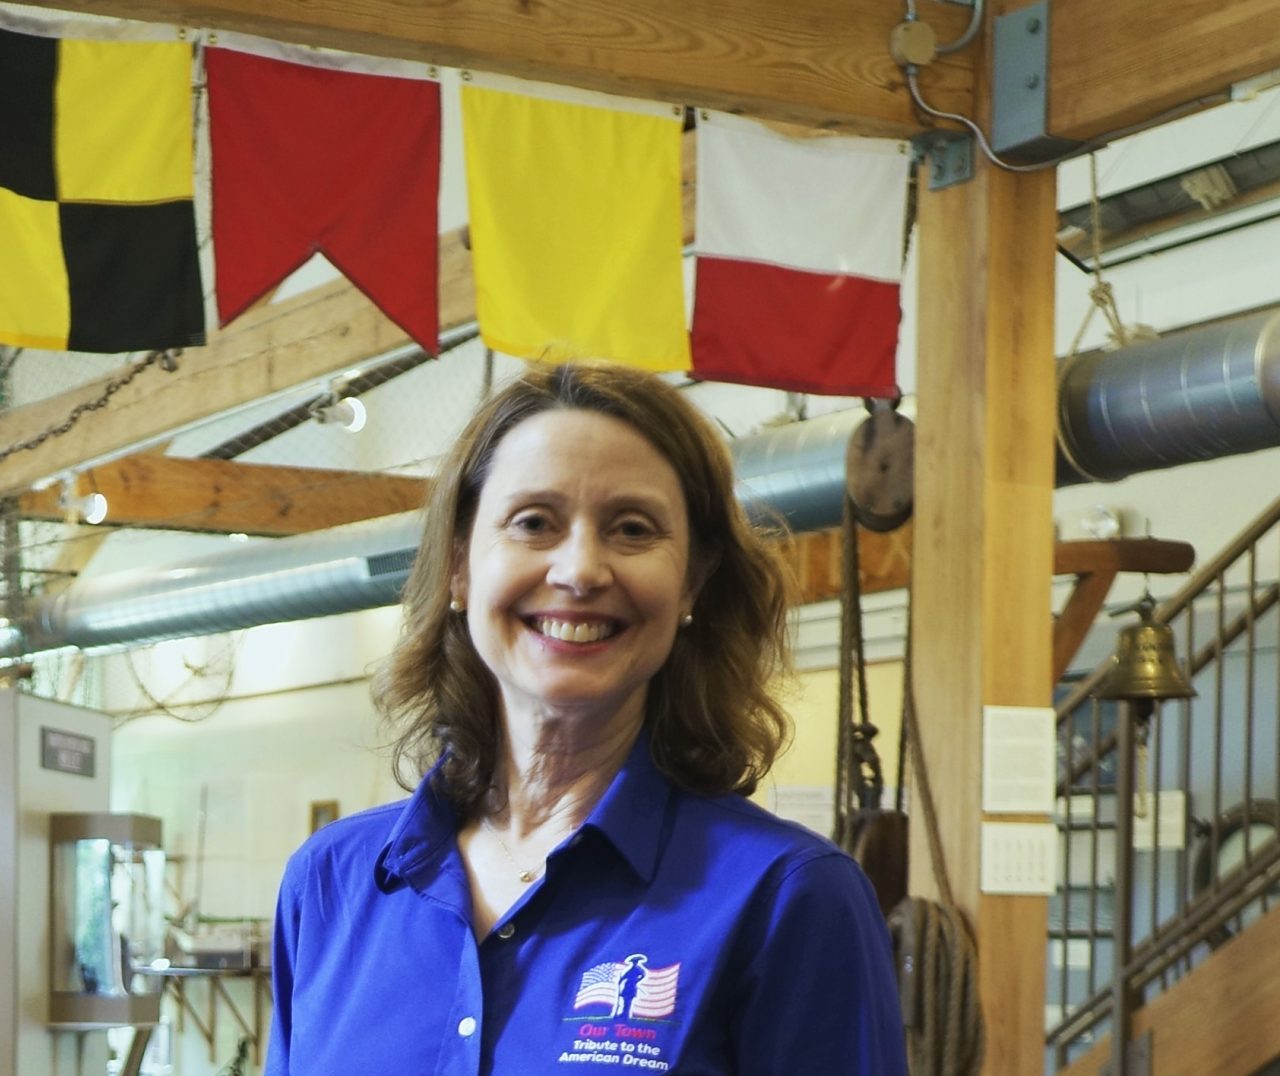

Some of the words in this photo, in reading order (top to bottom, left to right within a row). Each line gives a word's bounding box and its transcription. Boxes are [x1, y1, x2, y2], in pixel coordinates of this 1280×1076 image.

[579, 1023, 608, 1038] Our
[614, 1023, 657, 1039] Town
[573, 1039, 618, 1051] Tribute
[620, 1041, 635, 1052] to
[637, 1042, 661, 1056] the
[558, 1050, 620, 1064] American
[623, 1053, 669, 1071] Dream
